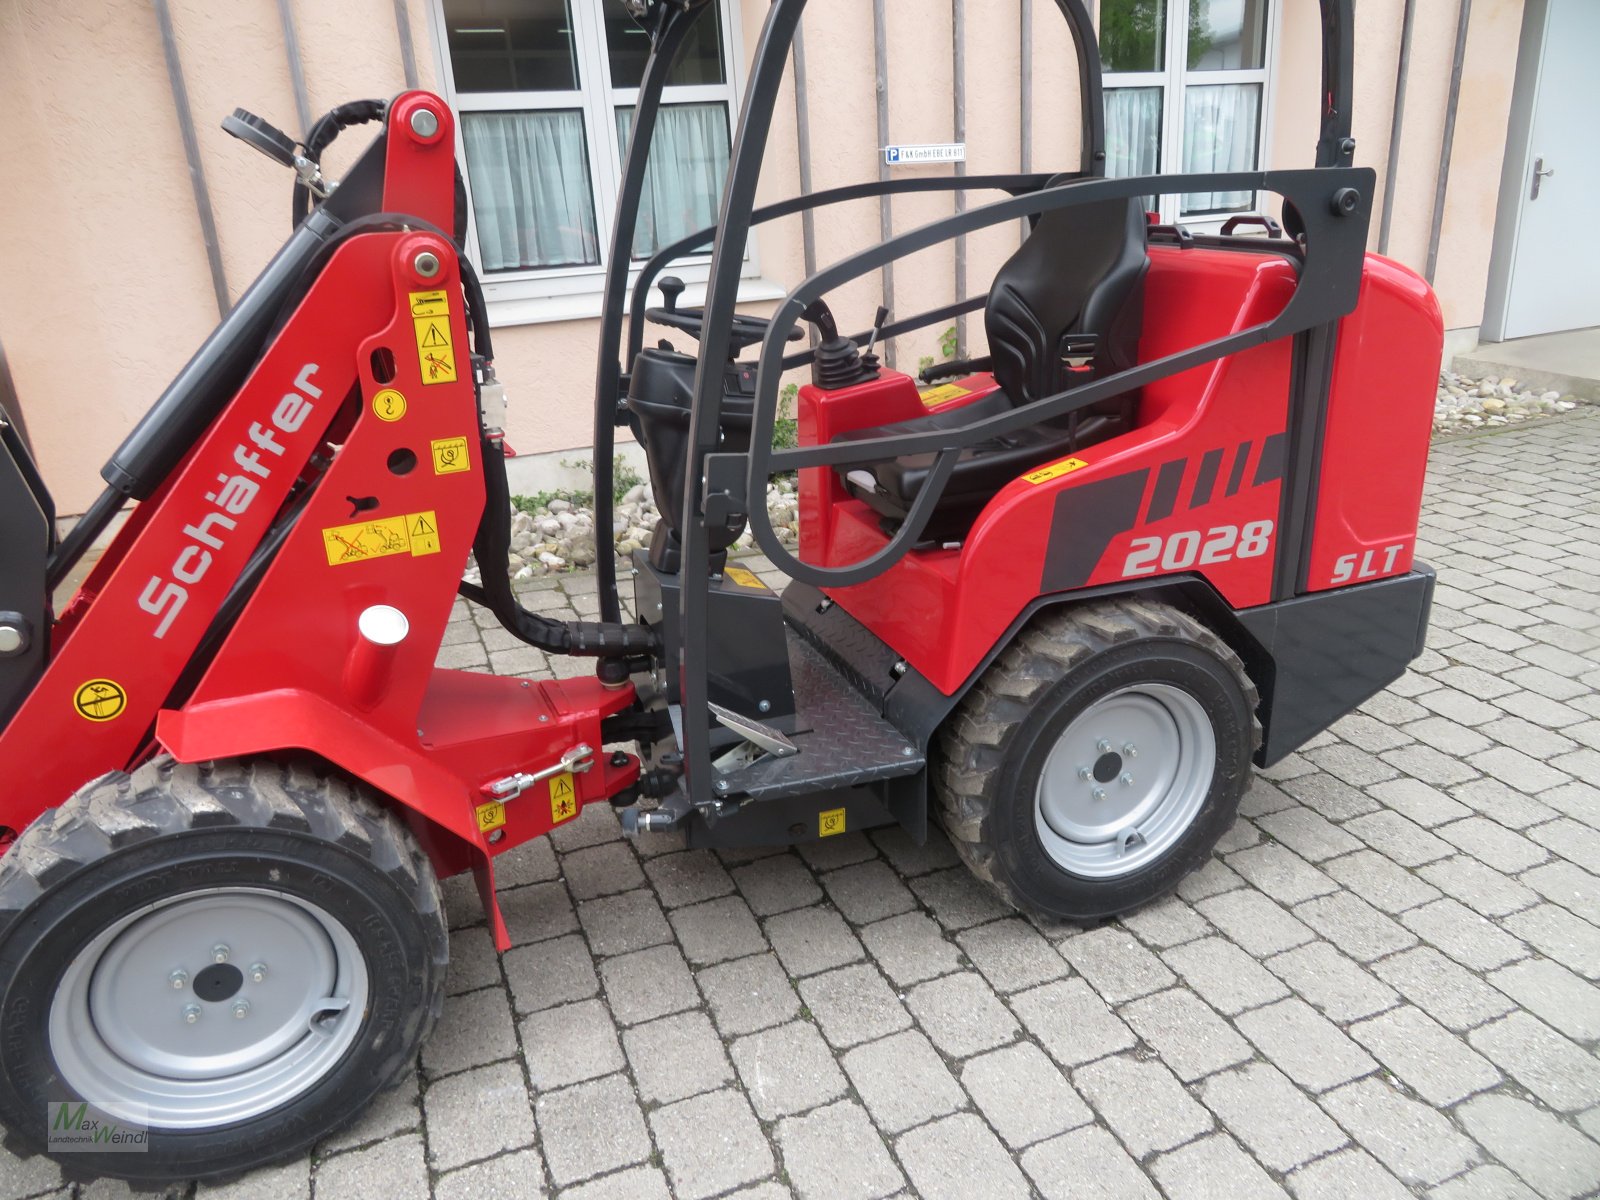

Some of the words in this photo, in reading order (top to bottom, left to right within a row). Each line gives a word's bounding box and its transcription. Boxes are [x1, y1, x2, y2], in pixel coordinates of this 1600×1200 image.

[890, 149, 898, 160] P
[138, 363, 323, 639] Schäffer
[1121, 519, 1274, 577] 2028
[1330, 545, 1403, 583] SLT
